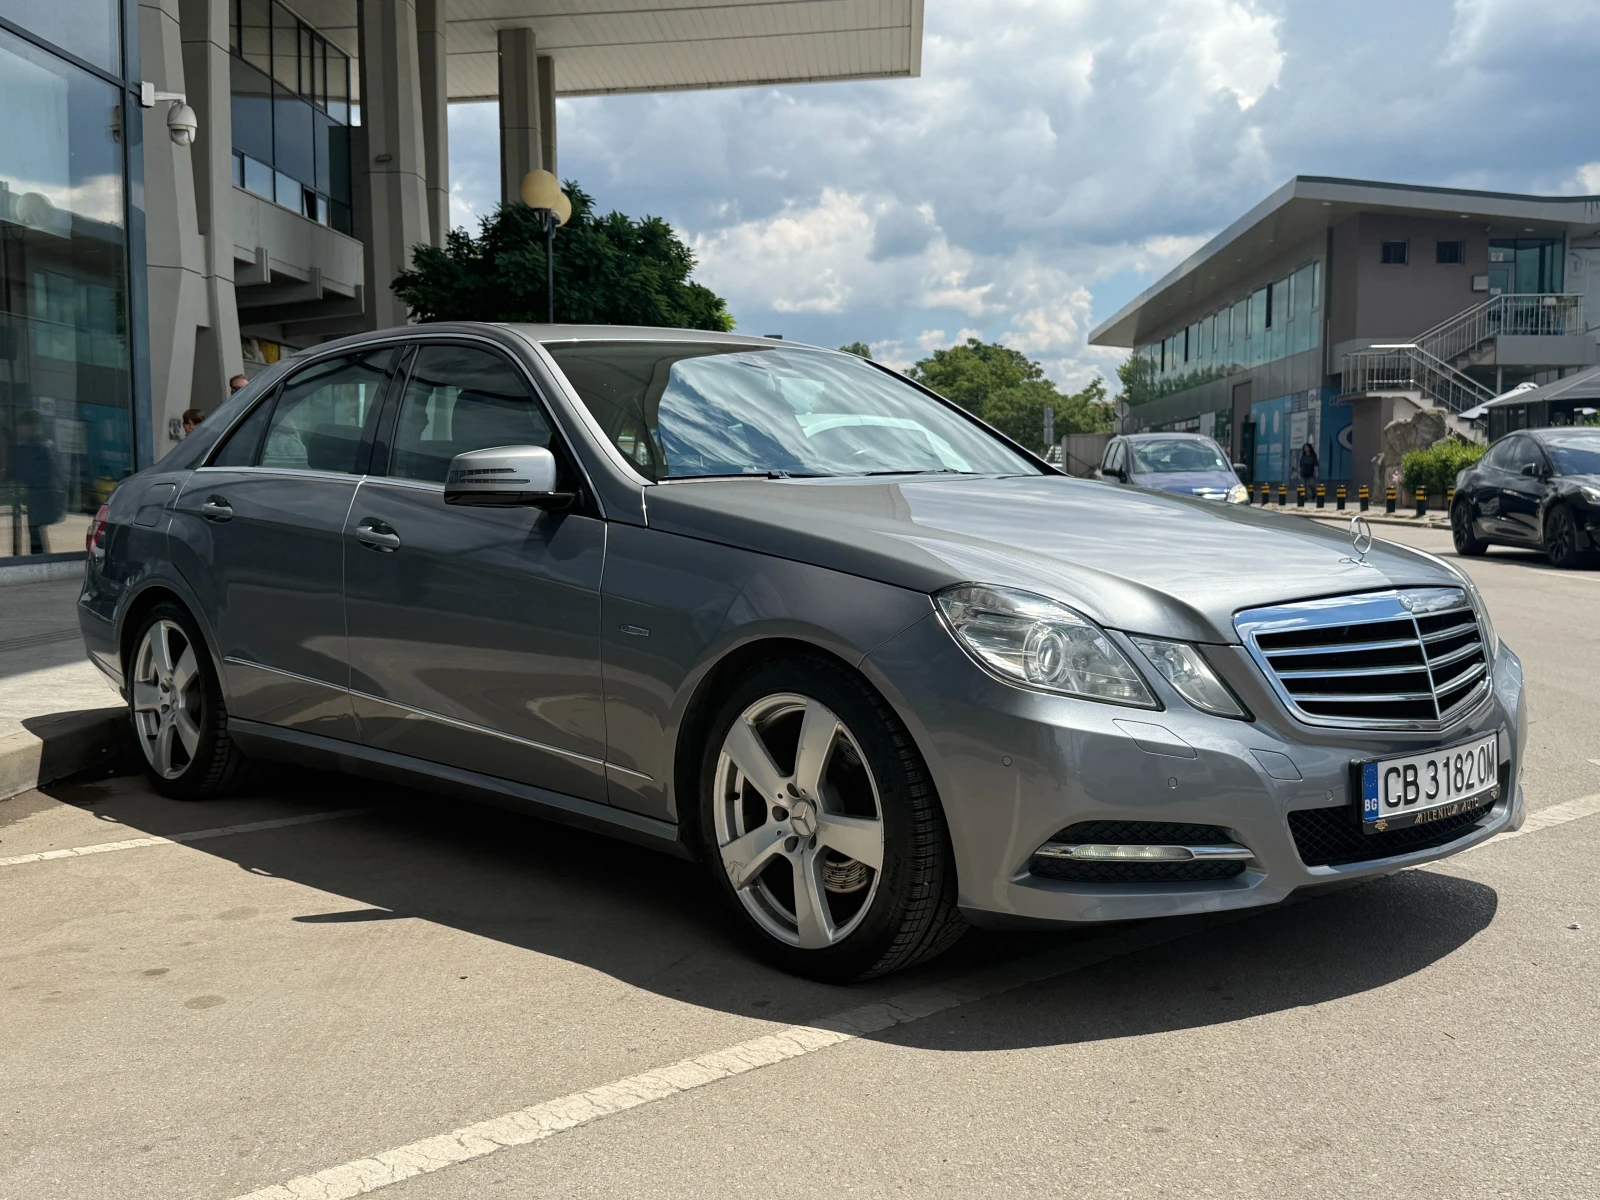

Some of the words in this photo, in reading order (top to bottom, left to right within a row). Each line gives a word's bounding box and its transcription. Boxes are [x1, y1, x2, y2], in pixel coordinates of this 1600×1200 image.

[1384, 763, 1420, 808] CB
[1425, 750, 1475, 800] 3182
[1477, 740, 1496, 785] OM
[1364, 798, 1378, 812] BG
[1414, 804, 1459, 824] MILENIUM
[1461, 798, 1479, 812] AUTO
